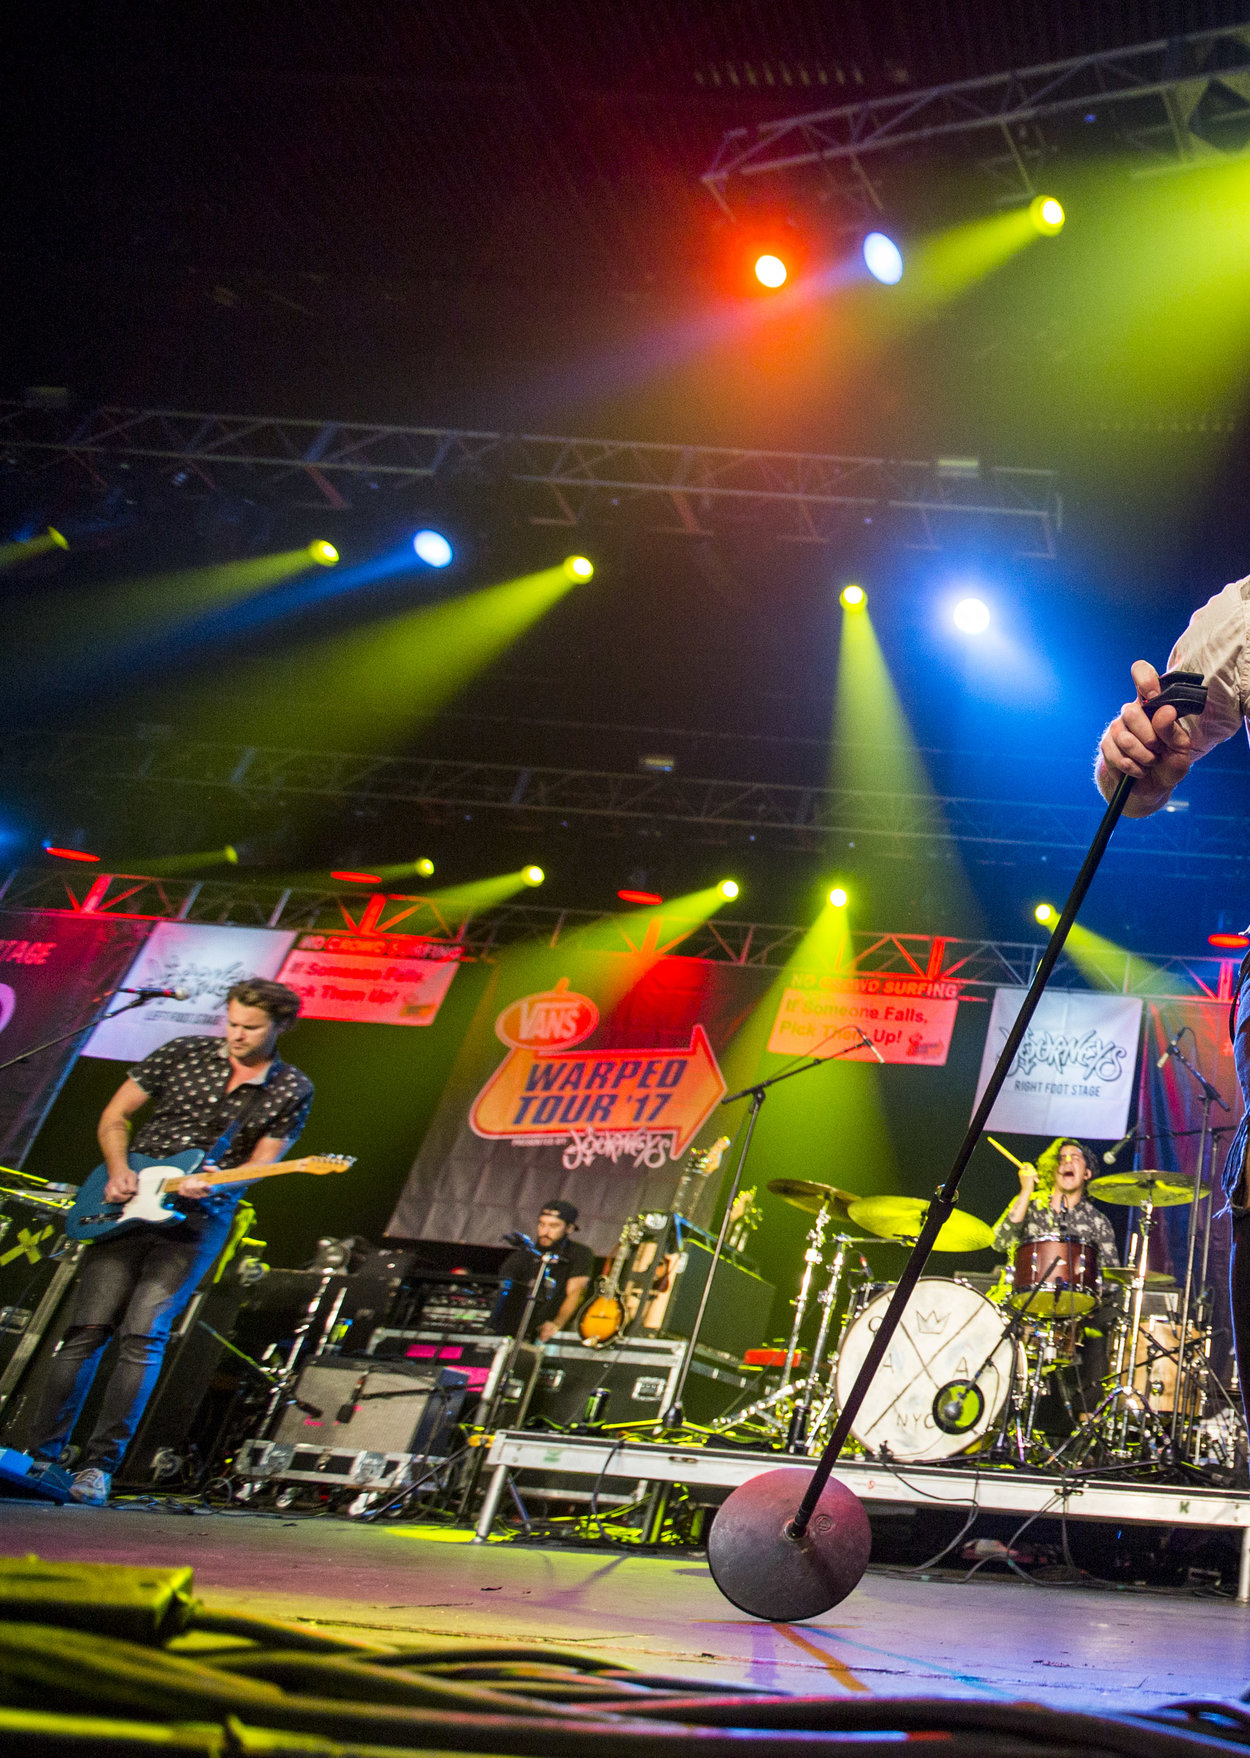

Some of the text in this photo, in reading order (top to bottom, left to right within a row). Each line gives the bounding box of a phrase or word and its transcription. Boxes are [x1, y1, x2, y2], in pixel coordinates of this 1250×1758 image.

[882, 980, 958, 998] SURFING
[519, 1001, 581, 1040] VANS
[802, 1001, 879, 1019] Someone
[779, 1020, 814, 1037] Pick
[873, 1029, 902, 1046] Up!
[525, 1059, 688, 1092] WARPED
[1014, 1080, 1101, 1097] RIGHT FOOT STAGE
[513, 1094, 672, 1125] TOUR '17
